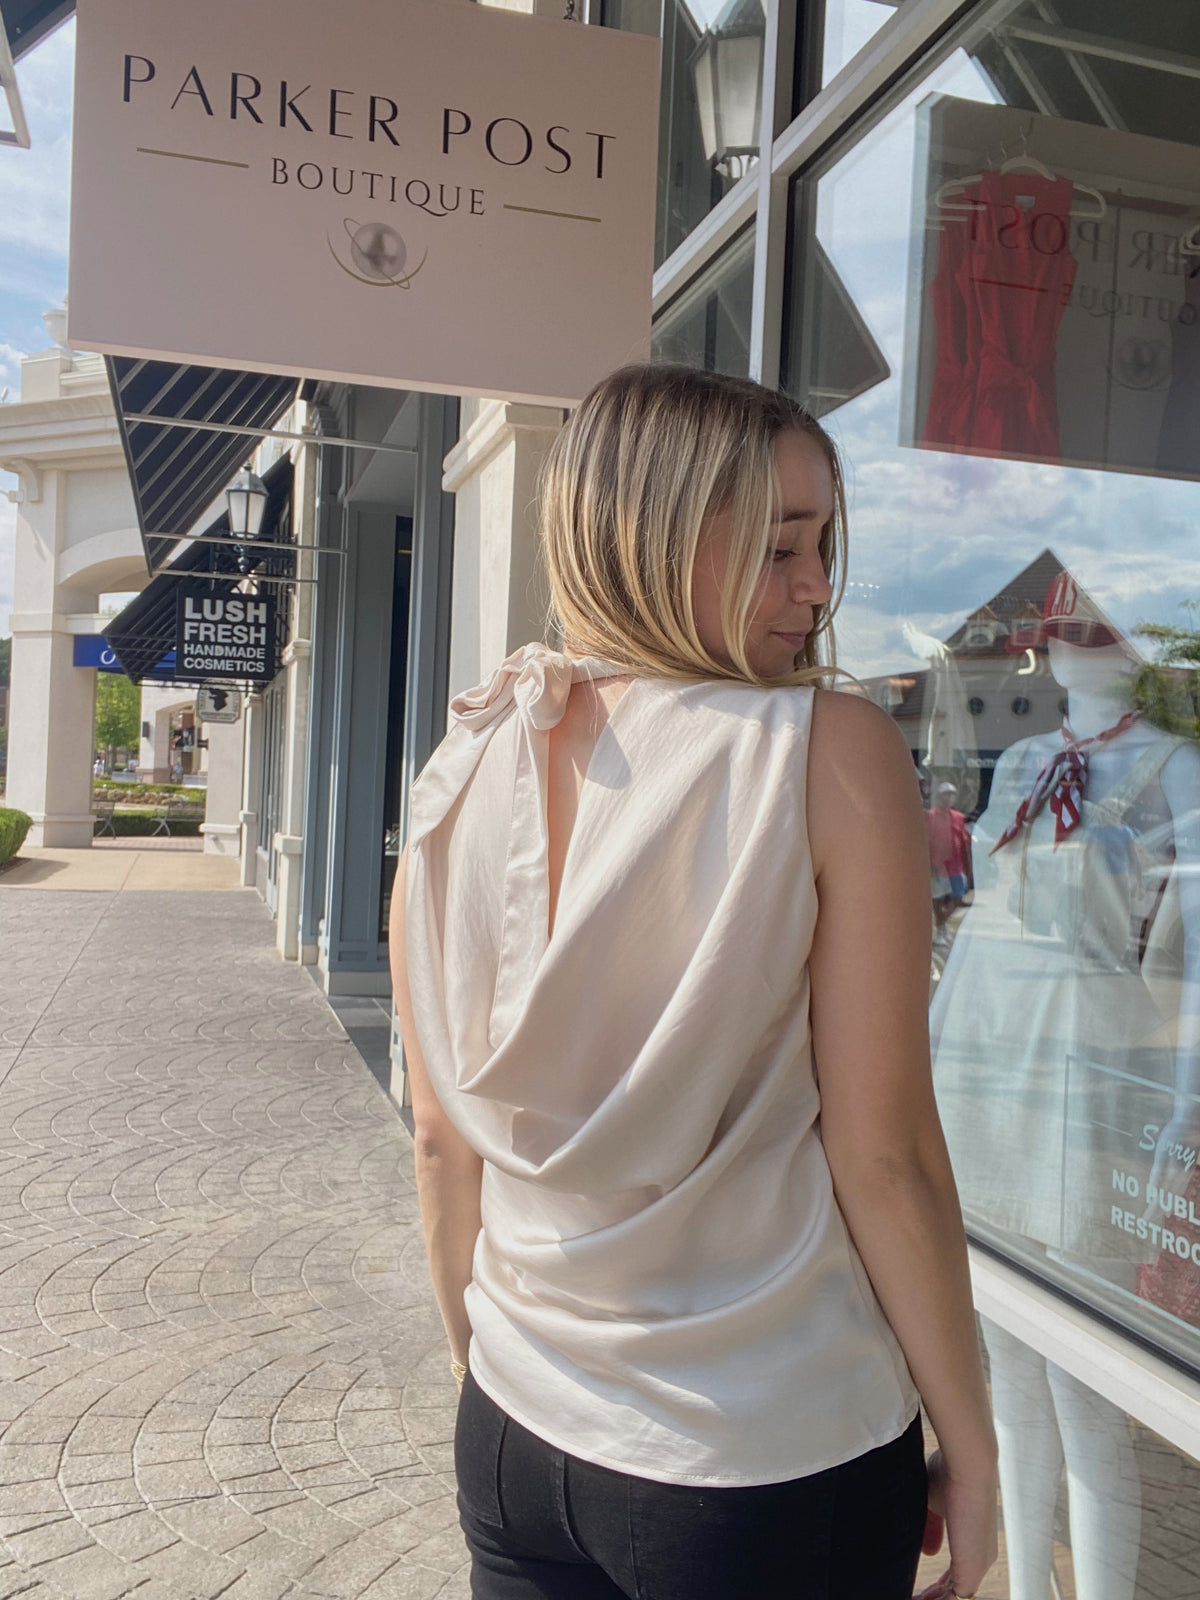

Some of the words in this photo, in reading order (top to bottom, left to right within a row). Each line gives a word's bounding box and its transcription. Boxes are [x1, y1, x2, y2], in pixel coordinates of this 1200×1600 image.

[122, 53, 401, 146] PARKER
[441, 107, 617, 179] POST
[271, 157, 486, 217] BOUTIQUE
[184, 596, 267, 624] LUSH
[184, 621, 267, 646] FRESH
[183, 642, 266, 659] HANDMADE
[183, 657, 266, 673] COSMETICS
[1112, 1168, 1140, 1198] NO
